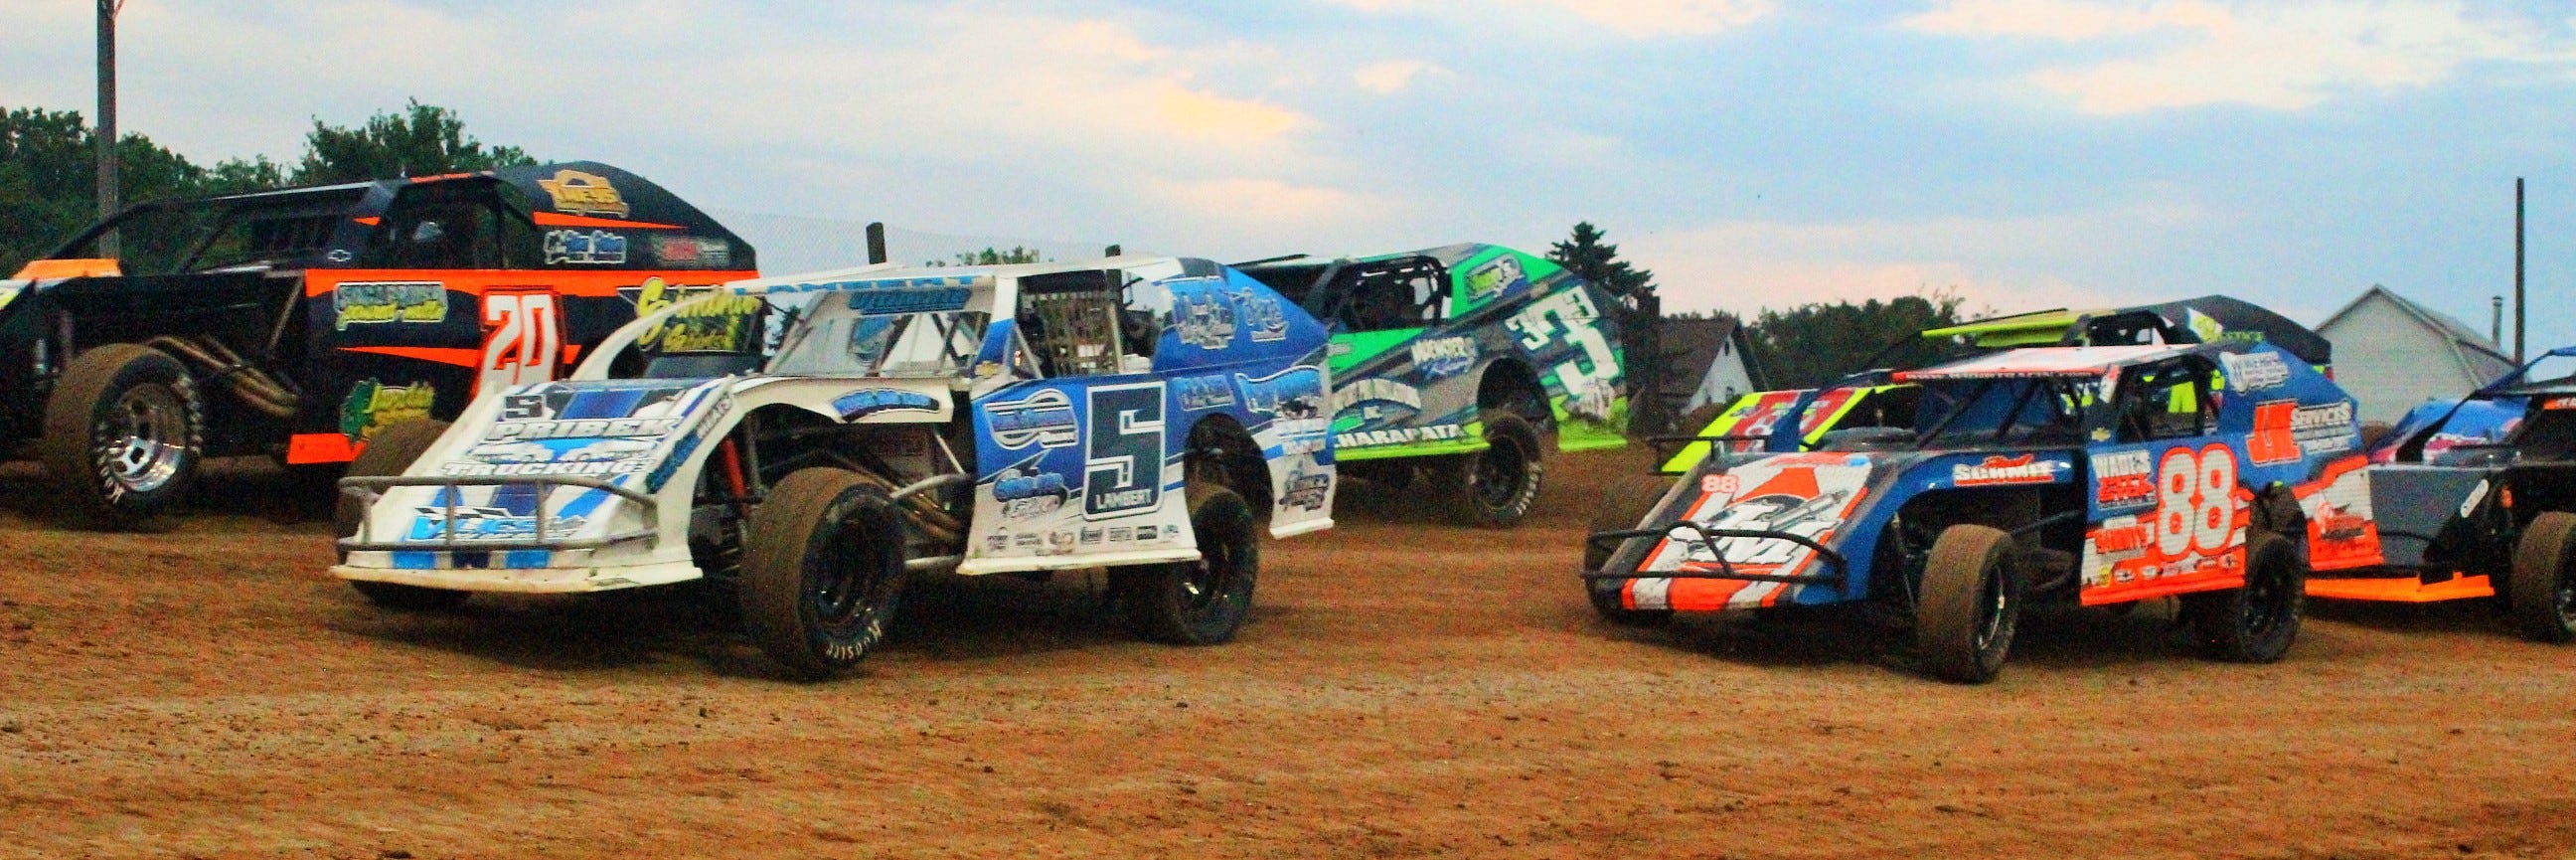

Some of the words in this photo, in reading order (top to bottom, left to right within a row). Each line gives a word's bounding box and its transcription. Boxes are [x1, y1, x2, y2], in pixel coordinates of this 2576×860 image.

[476, 293, 560, 395] 20
[484, 419, 678, 440] PRIBEK
[1081, 381, 1167, 522] 5
[1335, 424, 1465, 447] HARAPATA
[1700, 473, 1740, 494] 88
[2156, 442, 2238, 563] 88
